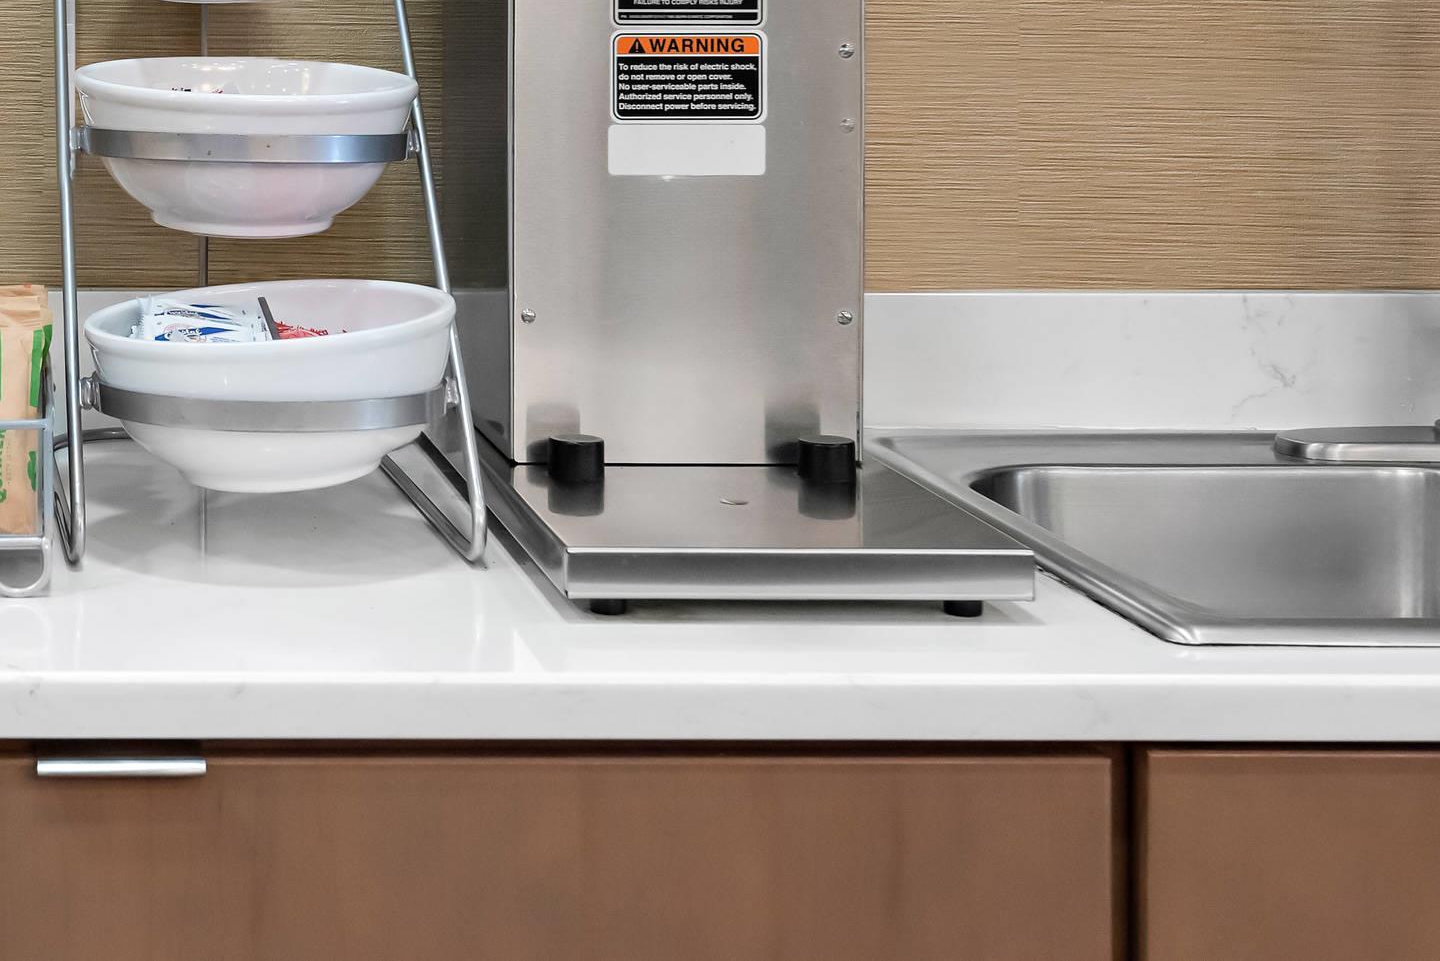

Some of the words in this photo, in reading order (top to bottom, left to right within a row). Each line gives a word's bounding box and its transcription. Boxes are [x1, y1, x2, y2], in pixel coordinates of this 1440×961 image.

[649, 38, 745, 53] WARNING
[618, 63, 629, 71] To
[630, 63, 658, 71] reduce
[658, 63, 672, 71] the
[673, 63, 689, 71] risk
[689, 63, 699, 71] of
[699, 63, 729, 71] electric
[730, 63, 757, 71] shock,
[693, 93, 733, 101] personnel
[734, 93, 754, 101] only.
[618, 102, 663, 110] Disconnect
[664, 104, 690, 112] power
[690, 102, 716, 110] before
[717, 102, 757, 112] servicing.
